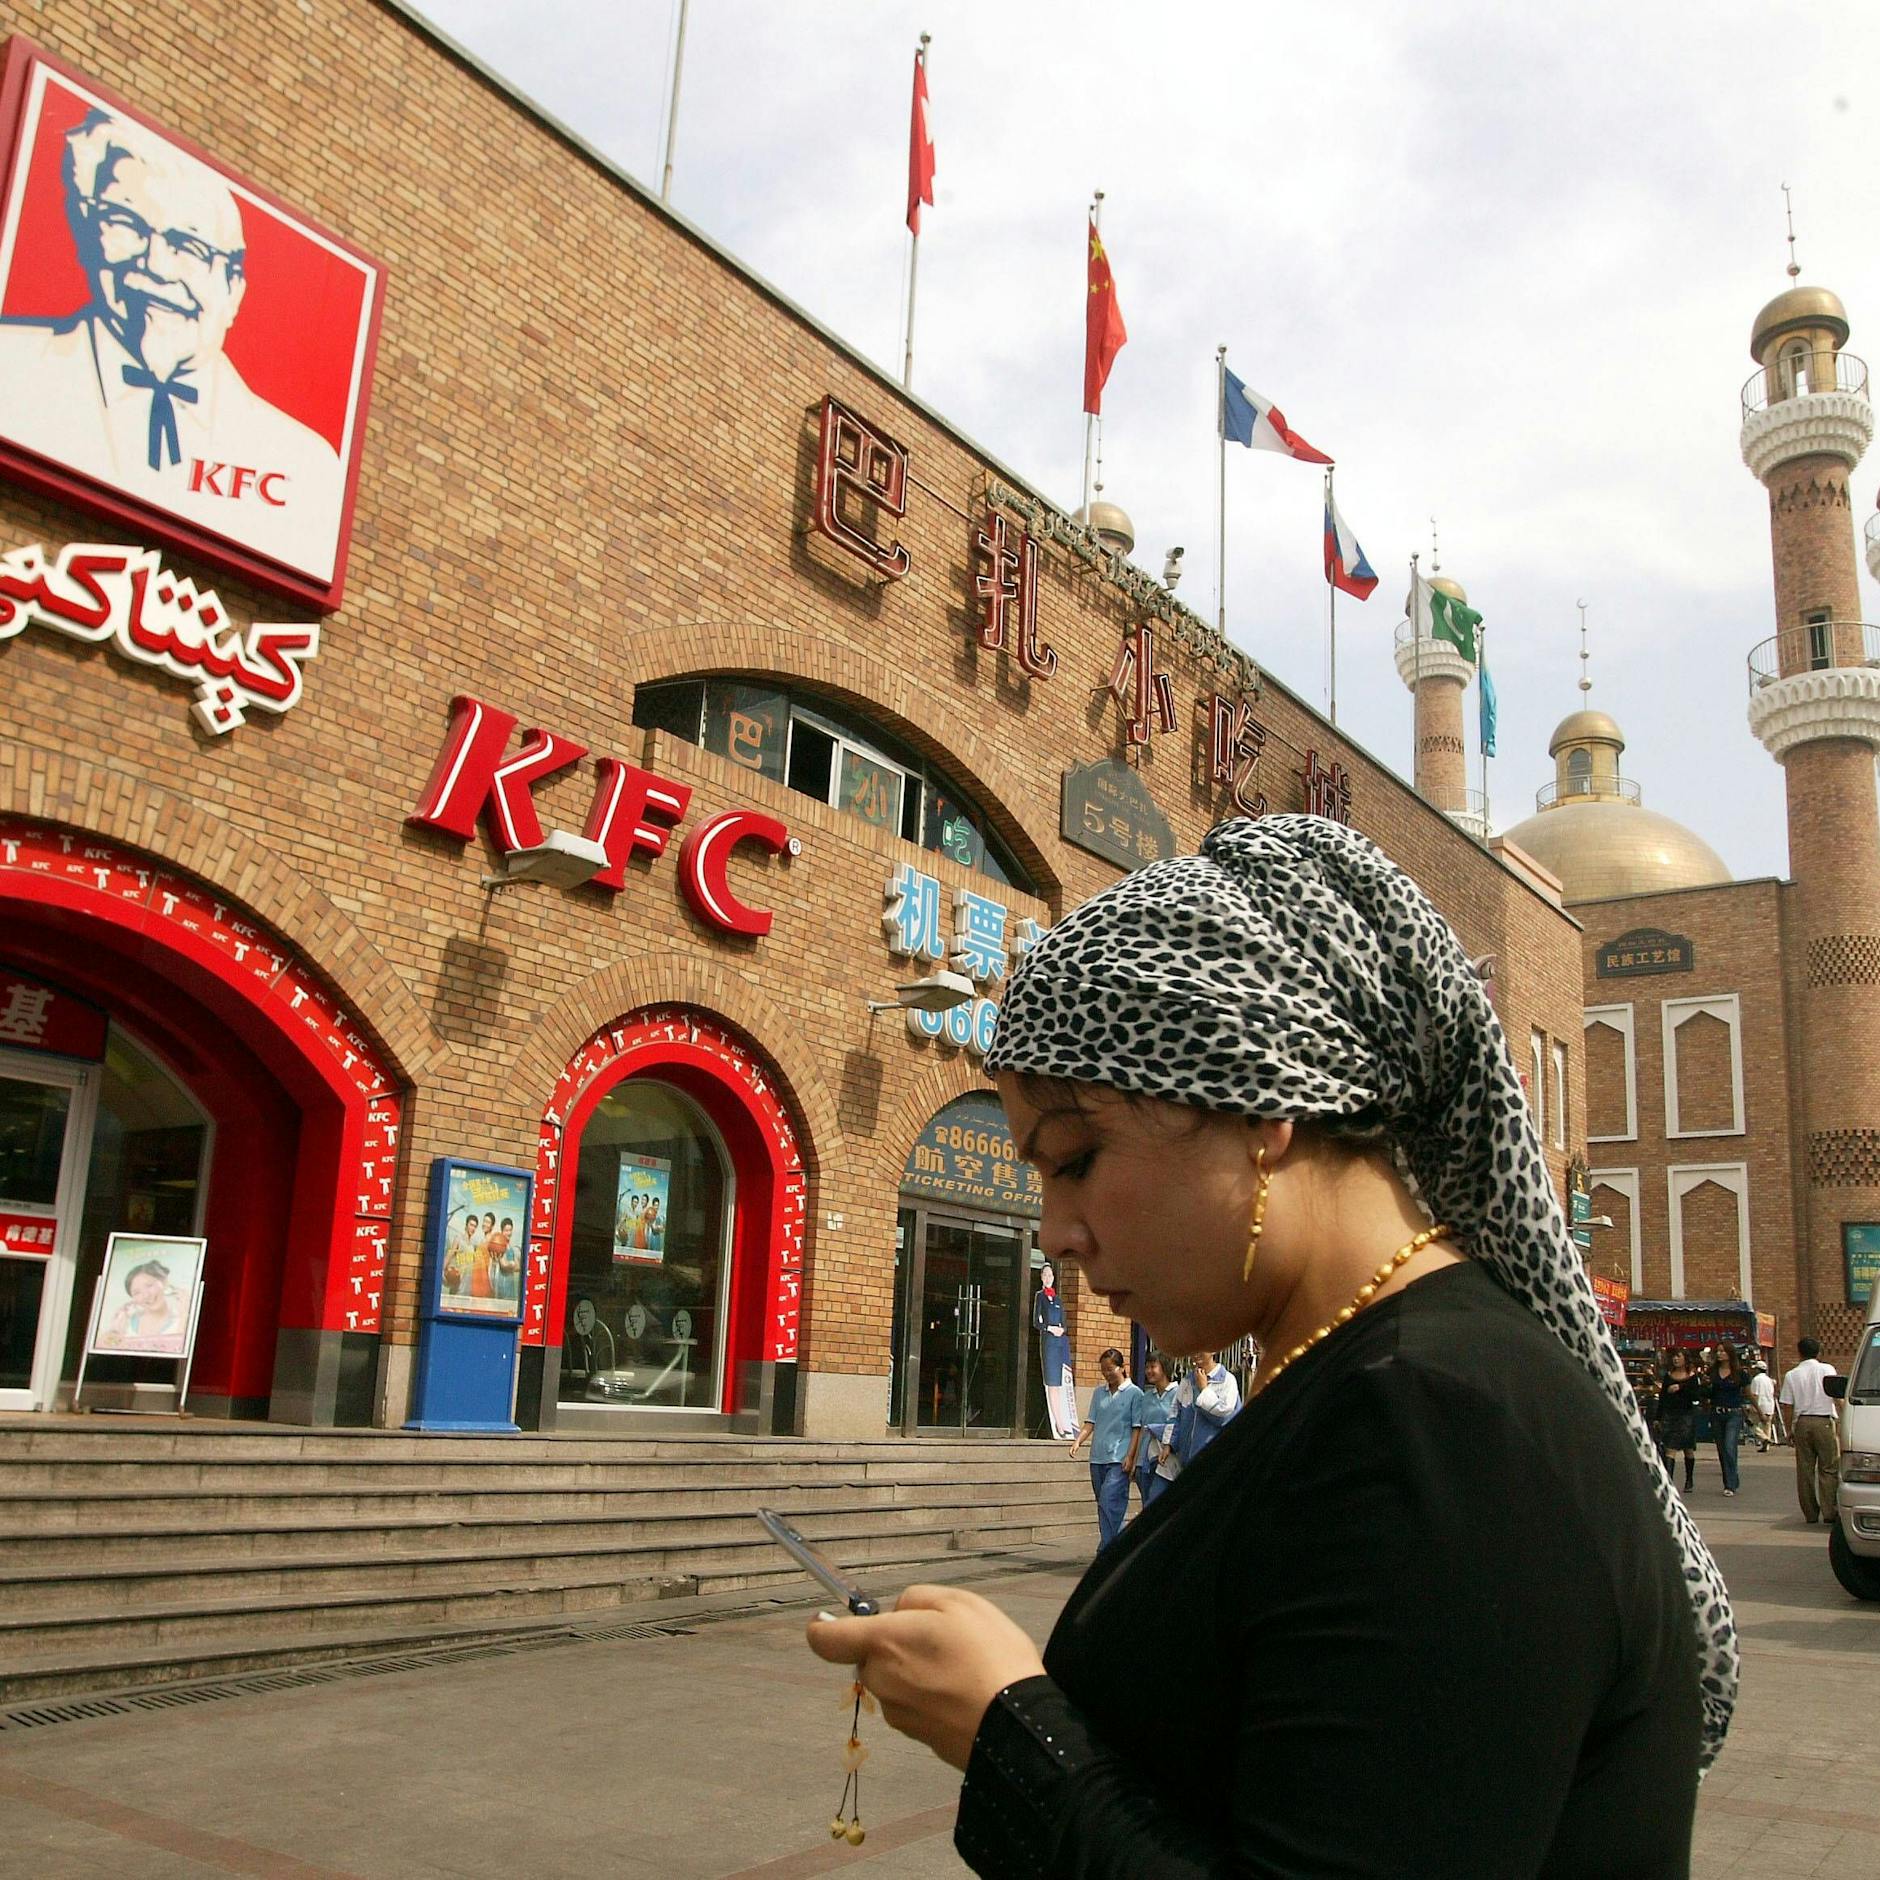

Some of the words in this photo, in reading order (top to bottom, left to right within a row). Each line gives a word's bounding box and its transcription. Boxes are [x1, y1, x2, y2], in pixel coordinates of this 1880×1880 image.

[186, 457, 287, 507] KFC
[404, 694, 788, 938] KFC
[84, 847, 113, 860] KFC
[32, 861, 51, 870] KFC
[66, 864, 86, 873] KFC
[122, 890, 141, 898] KFC
[231, 922, 258, 939] KFC
[0, 984, 55, 1044] 基
[346, 1032, 368, 1052] KFC
[367, 1112, 392, 1123] KFC
[904, 1173, 995, 1197] TICKETING
[1002, 1191, 1043, 1206] OFFI
[355, 1225, 380, 1237] KFC
[352, 1254, 368, 1262] KFC
[361, 1318, 377, 1326] KFC
